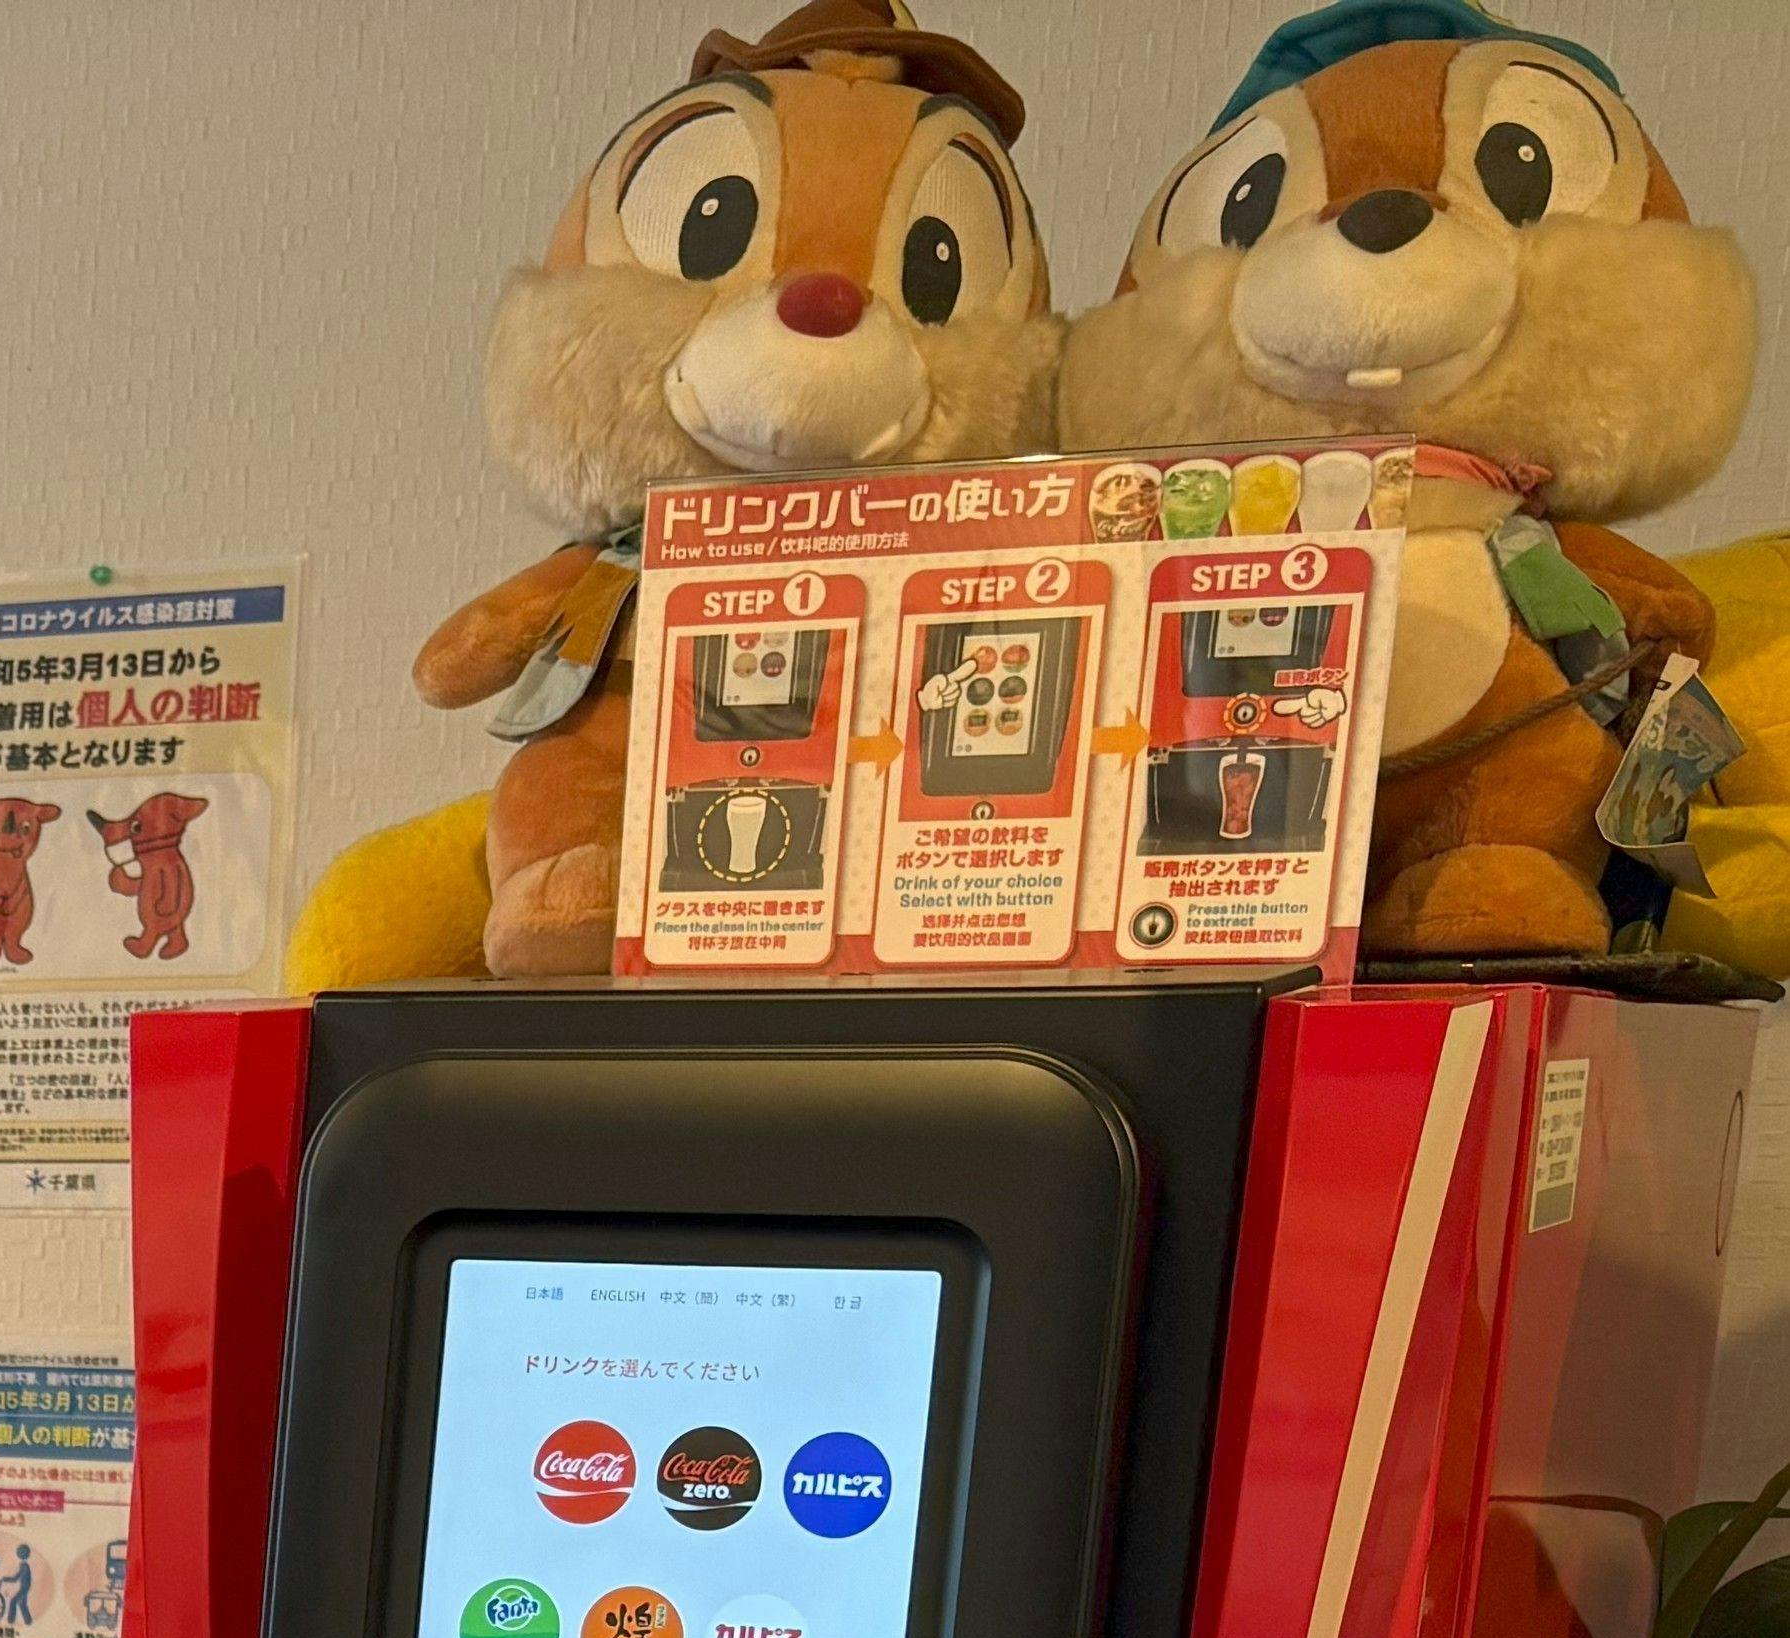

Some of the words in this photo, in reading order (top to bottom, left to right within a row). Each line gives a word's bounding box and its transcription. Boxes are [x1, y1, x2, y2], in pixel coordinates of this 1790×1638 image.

[661, 473, 1076, 540] ドリンクバーの使い方
[661, 543, 703, 561] How
[707, 544, 726, 558] to
[731, 543, 764, 556] use
[1191, 561, 1272, 595] STEP
[941, 576, 1016, 605] STEP
[703, 589, 774, 618] STEP
[915, 826, 1050, 847] ご希望の飲料を
[896, 848, 1065, 870] ボタンで選択します
[1144, 858, 1309, 878] 販売ボタンを押すと
[894, 875, 950, 890] Drink
[953, 875, 973, 889] of
[973, 876, 1006, 891] your
[1007, 874, 1062, 889] choice
[1169, 878, 1280, 899] 抽出されます
[656, 900, 825, 916] グラスを中央に置きます
[900, 892, 954, 908] Select
[957, 892, 993, 908] with
[996, 891, 1054, 906] button
[1188, 903, 1228, 916] Press
[1231, 903, 1258, 915] this
[1261, 902, 1308, 914] button
[654, 922, 688, 933] Place
[690, 922, 709, 933] the
[759, 922, 780, 932] the
[781, 920, 824, 932] center
[1187, 917, 1200, 927] to
[1203, 916, 1254, 927] extract
[526, 1286, 564, 1302] 日本語
[590, 1288, 646, 1303] ENGLISH
[525, 1355, 761, 1383] ドリンクを選んでください
[683, 1482, 731, 1500] zero
[792, 1471, 883, 1498] カルピス
[488, 1597, 539, 1625] Fanta
